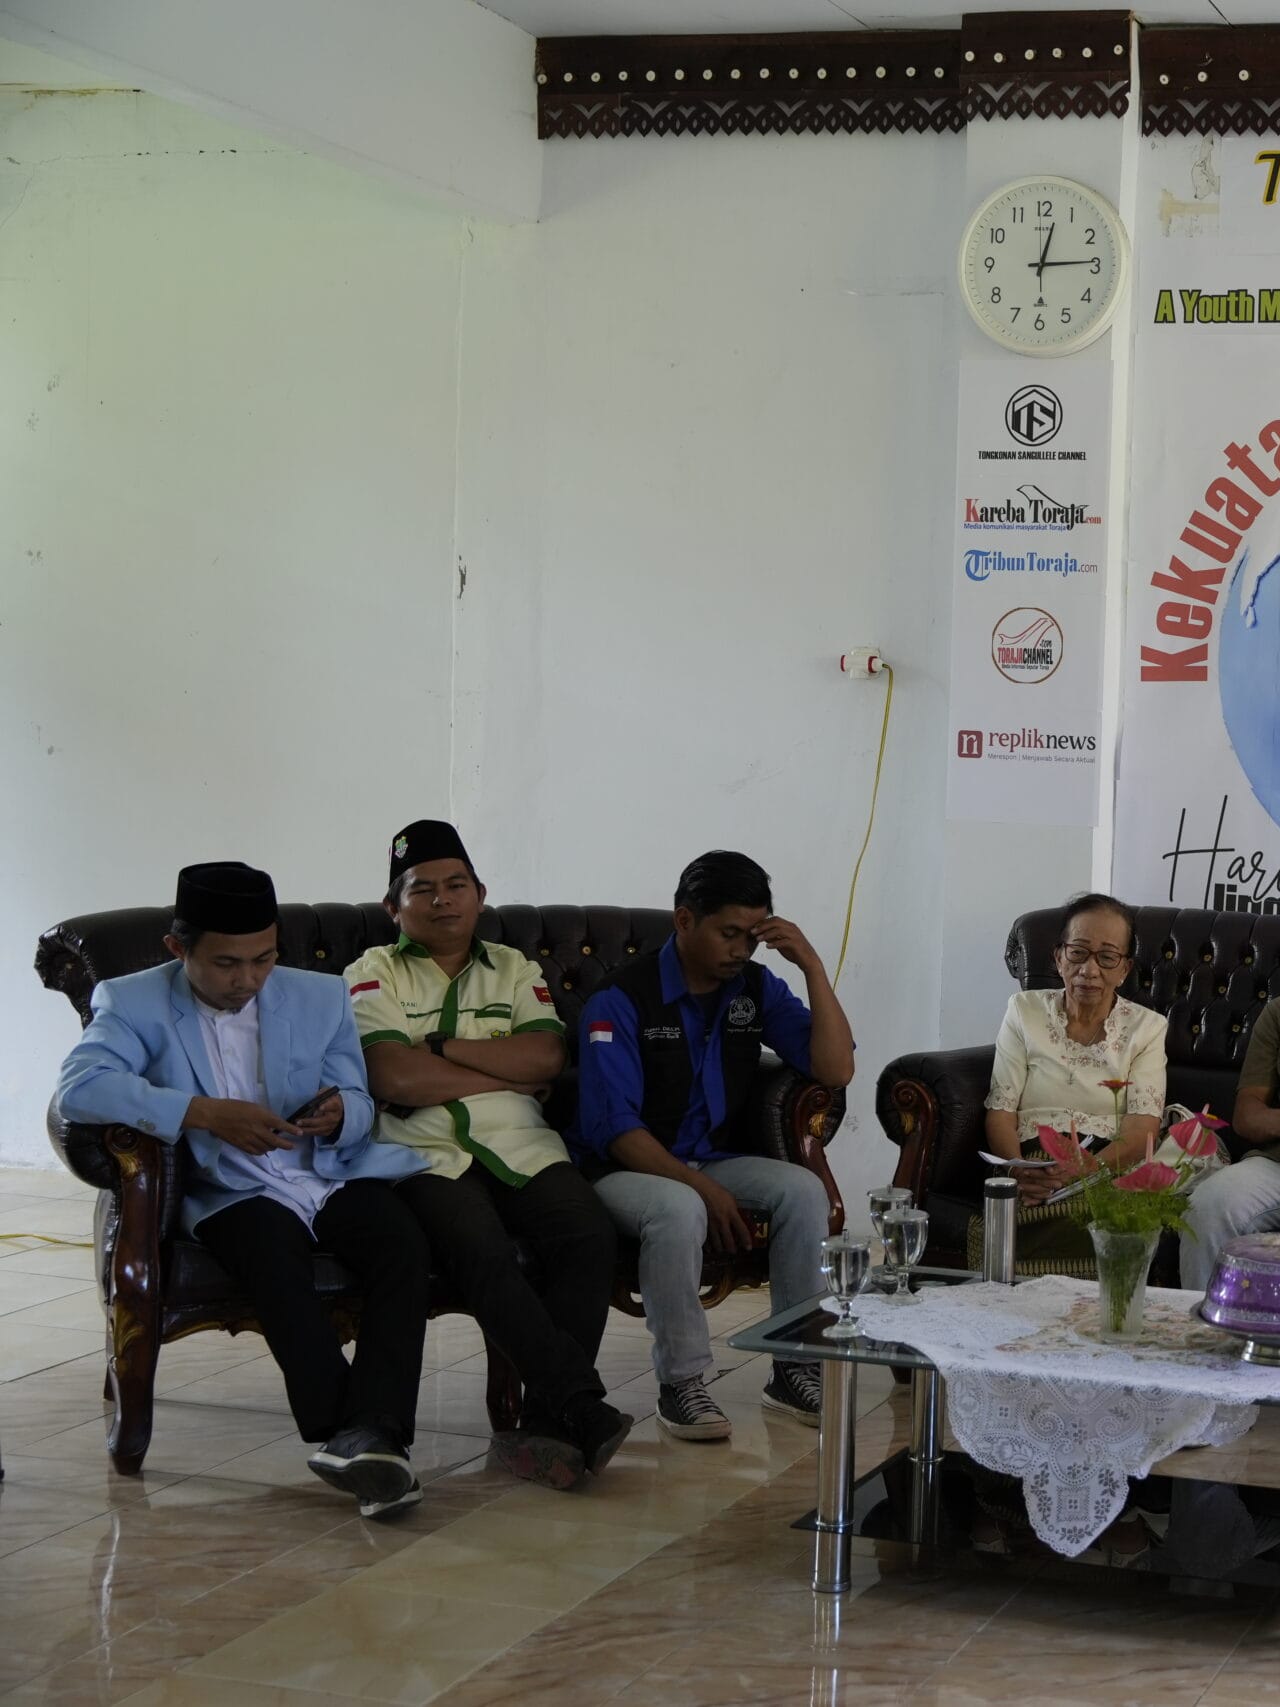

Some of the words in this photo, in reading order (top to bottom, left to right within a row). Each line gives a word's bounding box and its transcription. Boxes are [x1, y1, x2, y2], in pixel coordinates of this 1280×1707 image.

[1012, 207, 1024, 223] 11
[1037, 201, 1053, 217] 12
[1070, 207, 1074, 223] 1
[990, 228, 1005, 244] 10
[1084, 228, 1096, 245] 2
[984, 256, 996, 274] 9
[1089, 257, 1101, 275] 3
[990, 286, 1002, 304] 8
[1080, 287, 1092, 304] 4
[1154, 290, 1176, 325] A
[1179, 288, 1255, 325] Youth
[1009, 307, 1022, 324] 7
[1034, 313, 1045, 331] 6
[1060, 307, 1072, 324] 5
[978, 450, 1017, 460] TONGKONAN
[1058, 451, 1087, 461] CHANNEL
[964, 499, 1025, 524] Kareba
[982, 523, 1015, 531] komunikasi
[1015, 524, 1048, 533] masyarakat
